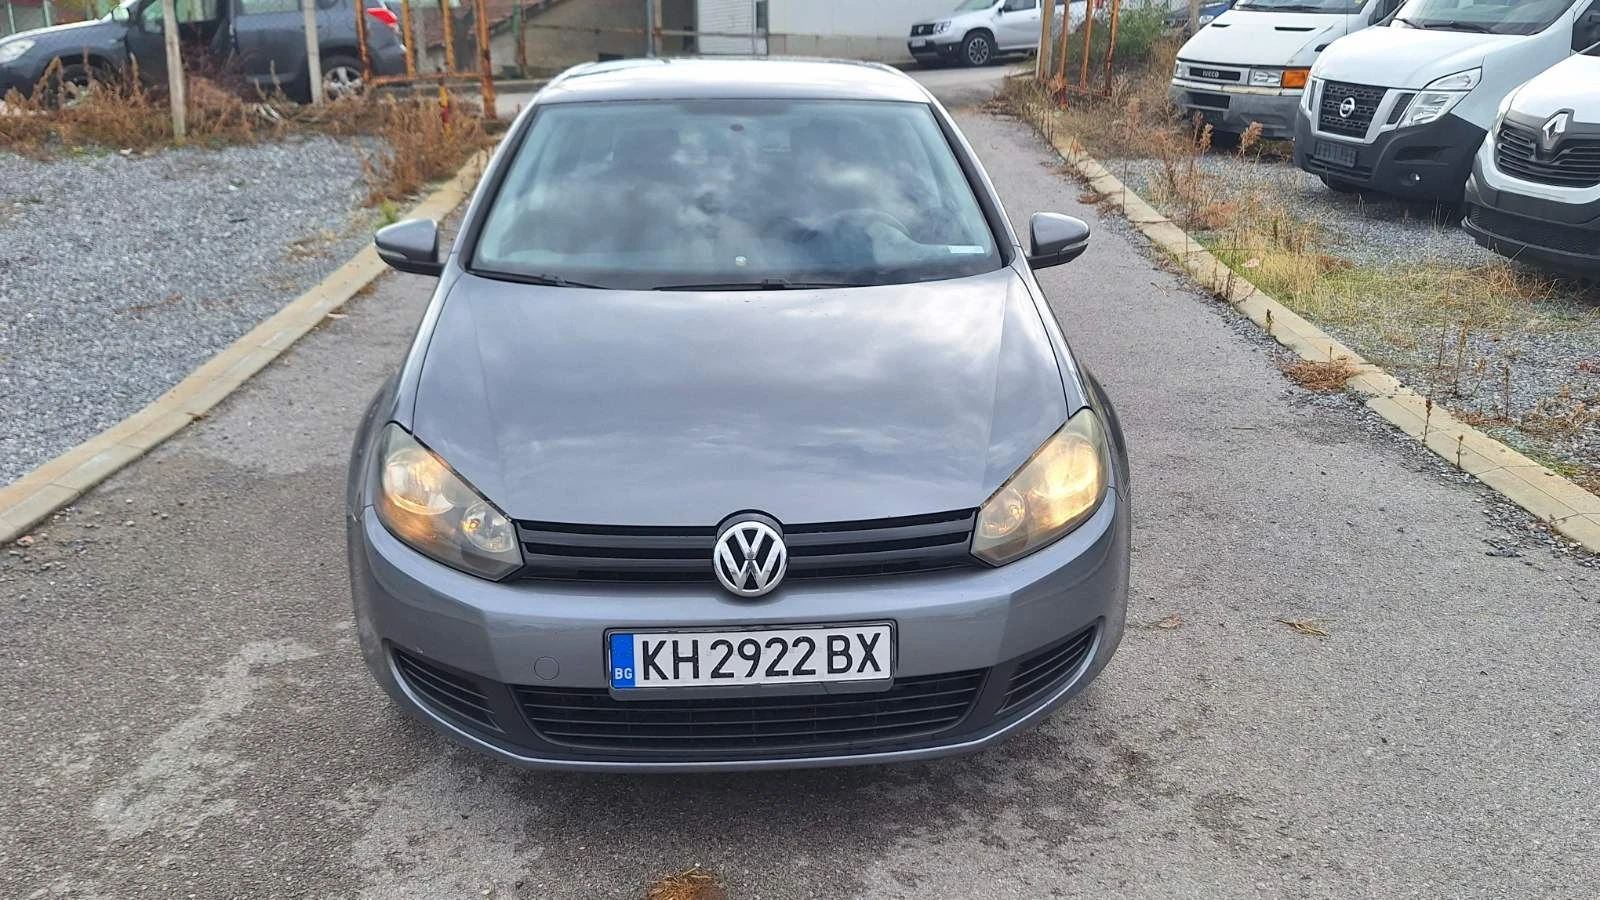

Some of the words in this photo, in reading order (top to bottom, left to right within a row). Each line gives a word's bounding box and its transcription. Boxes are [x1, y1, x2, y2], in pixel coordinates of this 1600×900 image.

[641, 639, 700, 680] KH
[710, 636, 817, 678] 2922
[826, 632, 882, 674] BX
[614, 667, 633, 680] BG
